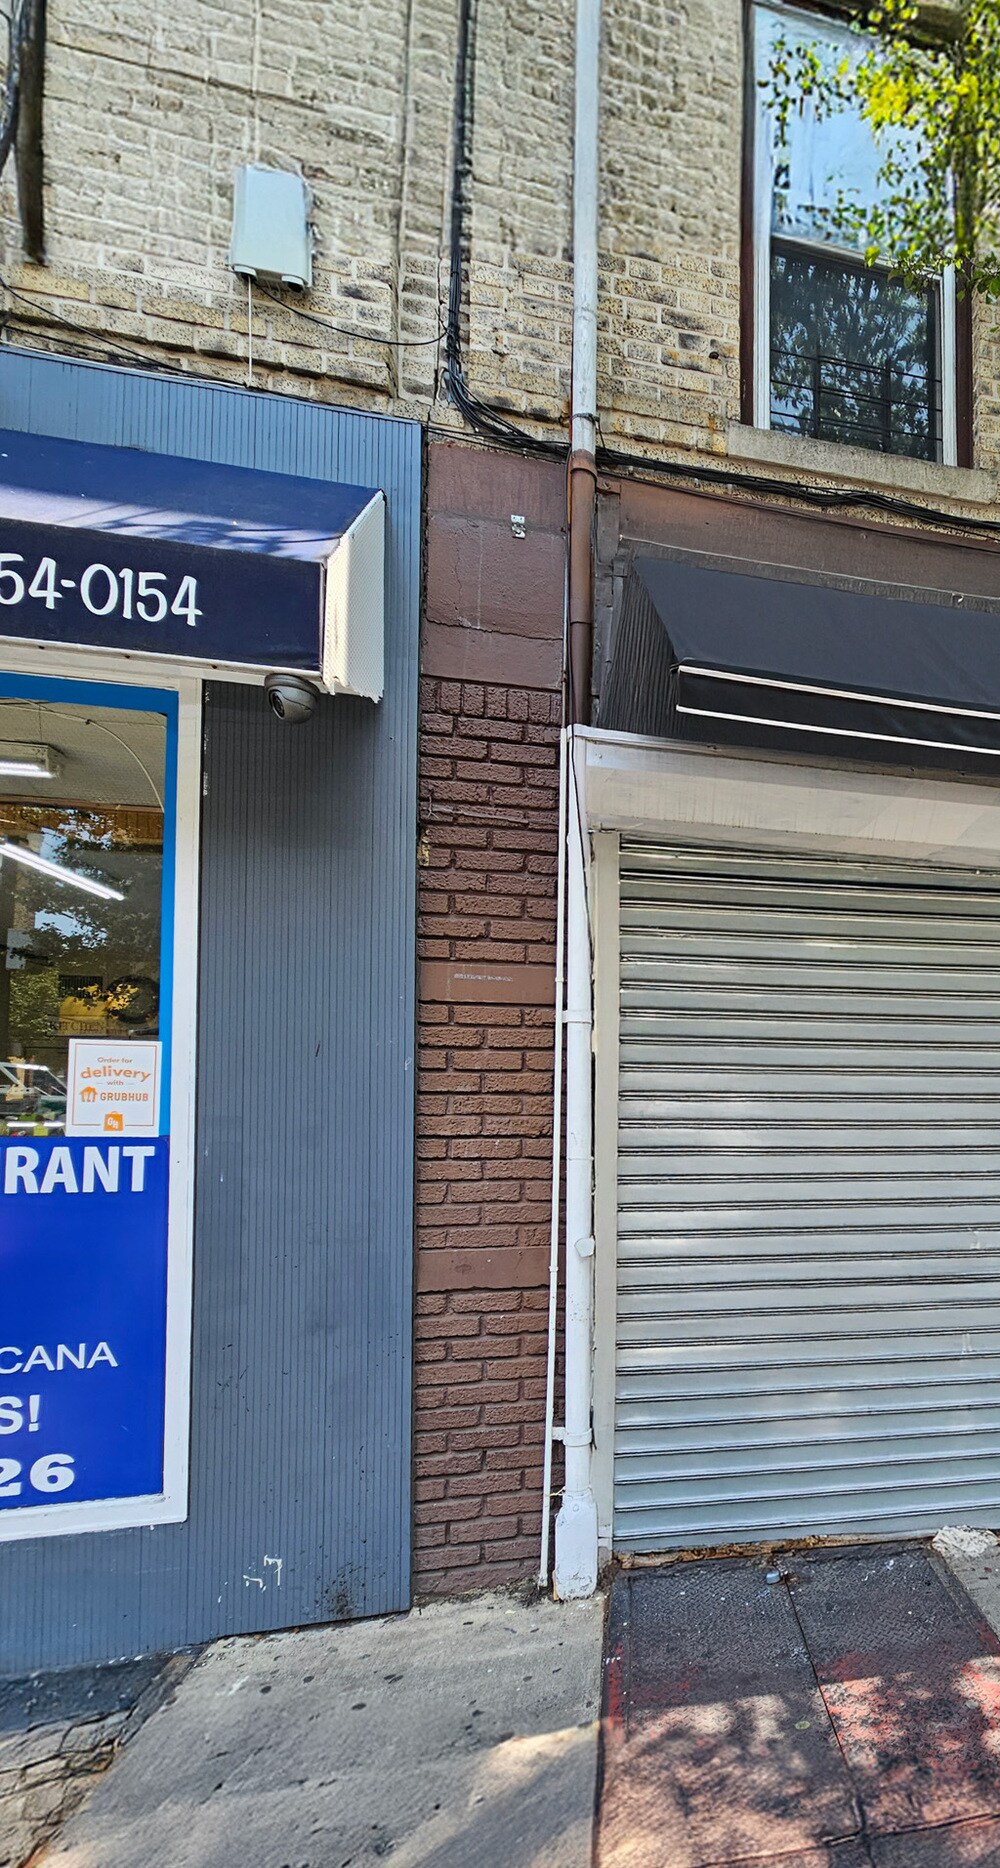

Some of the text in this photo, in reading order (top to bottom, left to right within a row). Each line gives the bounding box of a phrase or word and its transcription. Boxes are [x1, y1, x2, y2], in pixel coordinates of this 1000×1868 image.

[97, 1056, 120, 1064] Order
[80, 1065, 151, 1083] delivery
[100, 1092, 149, 1102] GRUBHUB
[0, 1341, 118, 1374] CANA
